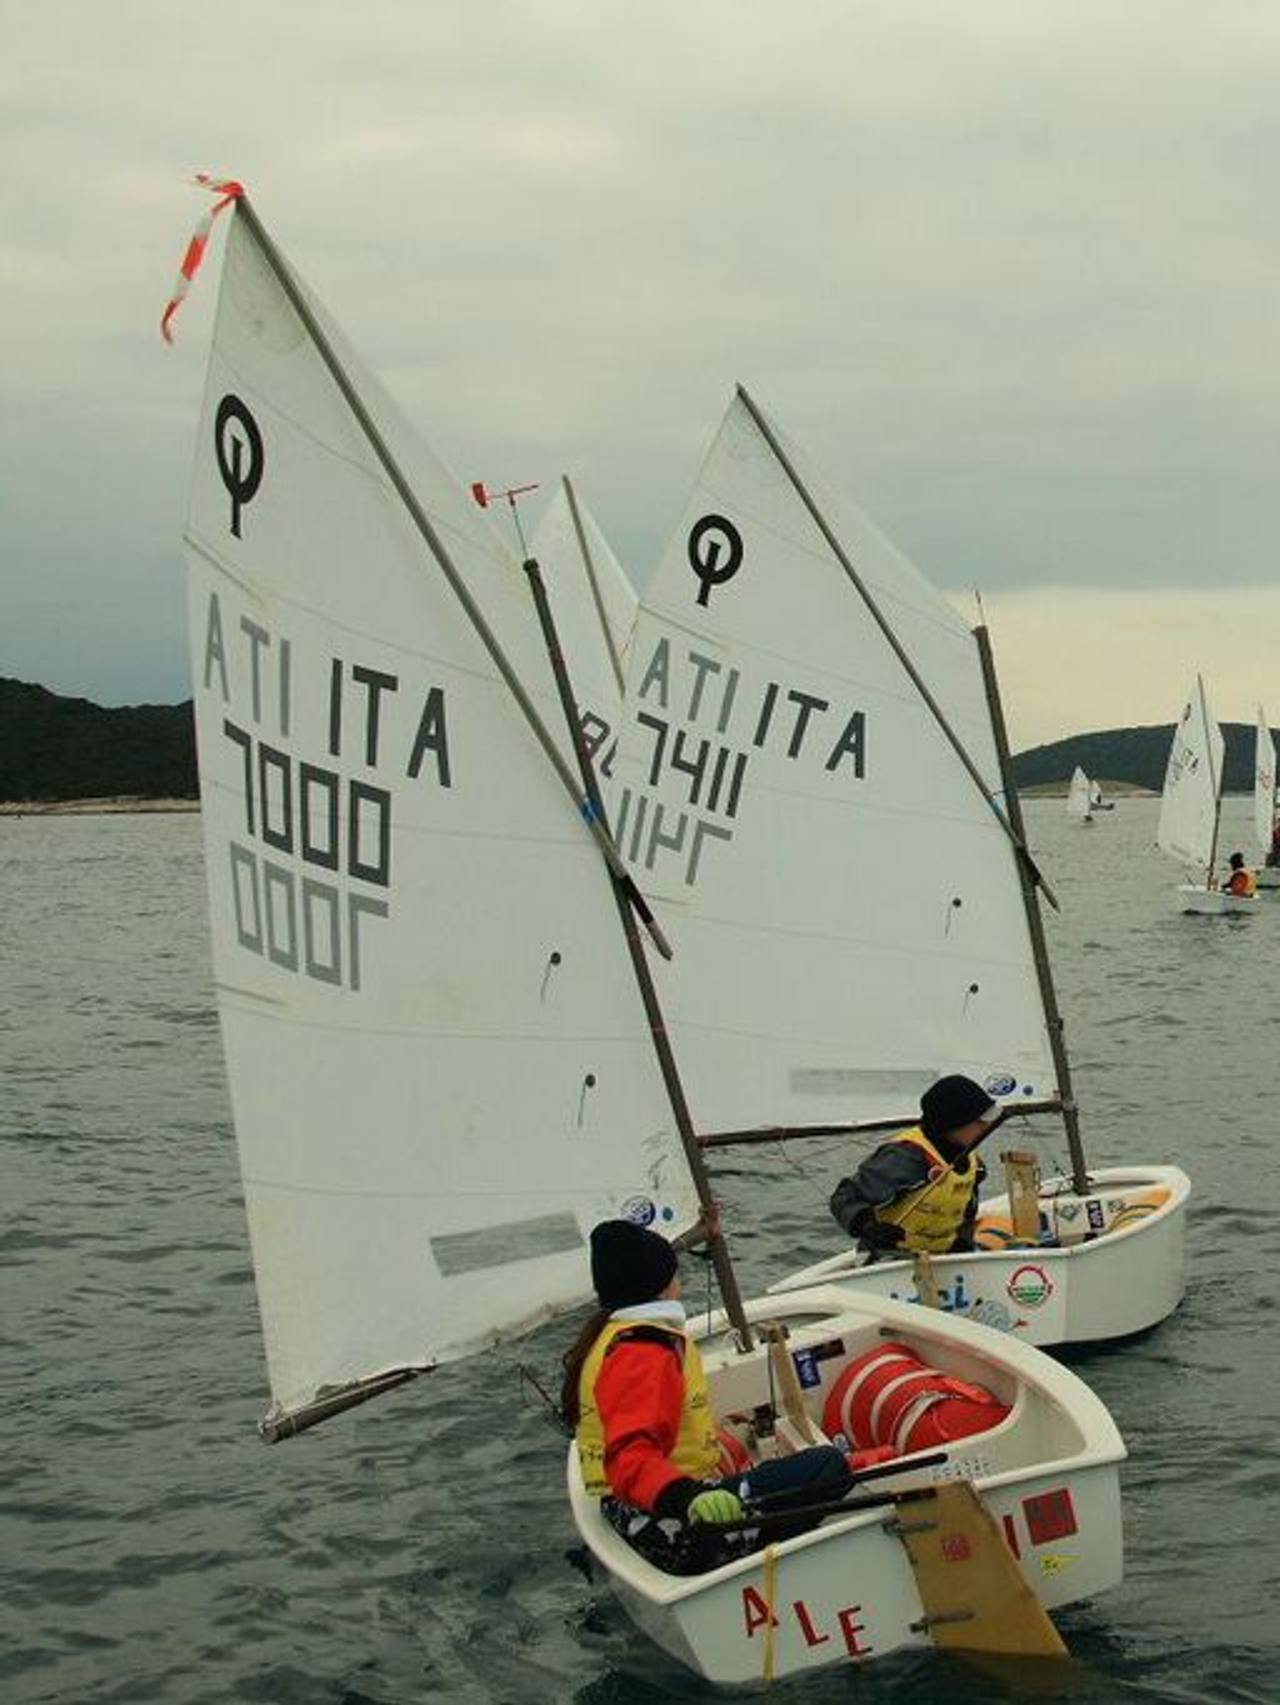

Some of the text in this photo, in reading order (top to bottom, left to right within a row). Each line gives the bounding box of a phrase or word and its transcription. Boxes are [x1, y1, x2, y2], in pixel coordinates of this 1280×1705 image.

[329, 657, 451, 788] ITA
[637, 711, 748, 818] 7411
[753, 683, 866, 779] ITA
[223, 718, 391, 887] 7000
